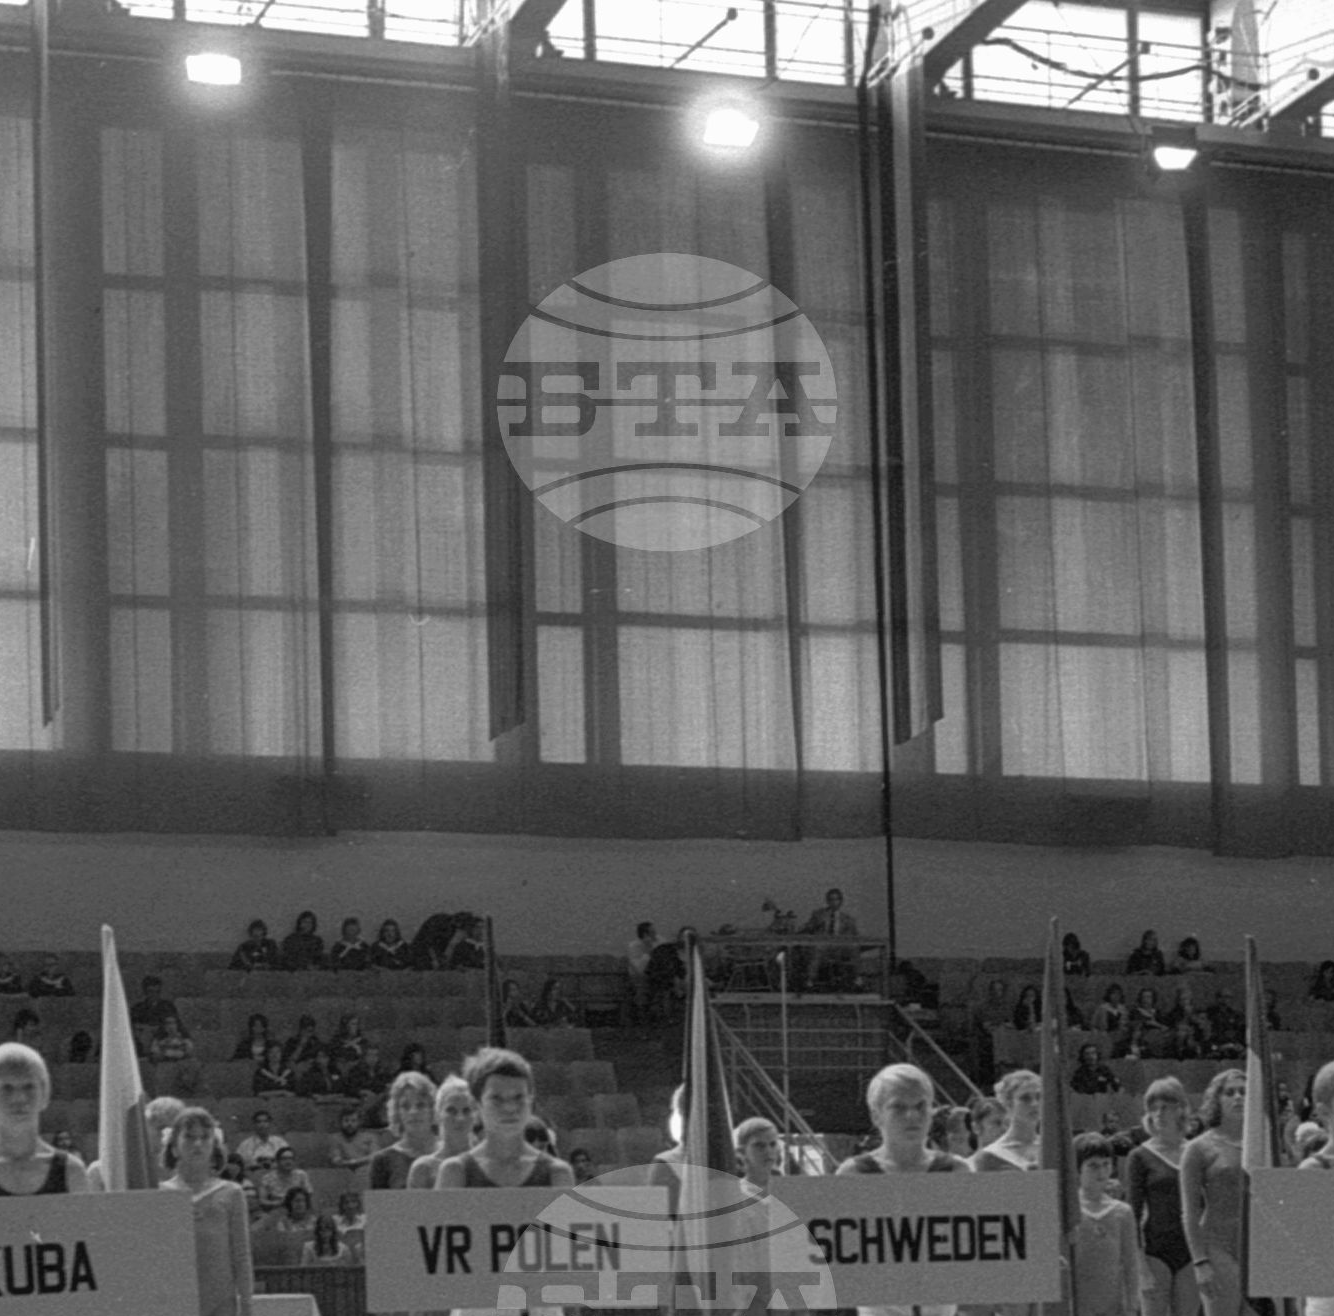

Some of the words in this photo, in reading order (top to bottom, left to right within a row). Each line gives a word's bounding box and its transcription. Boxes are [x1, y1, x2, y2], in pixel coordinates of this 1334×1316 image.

[418, 1224, 472, 1275] VR
[490, 1222, 620, 1273] POLEN
[808, 1214, 1026, 1265] SCHWEDEN
